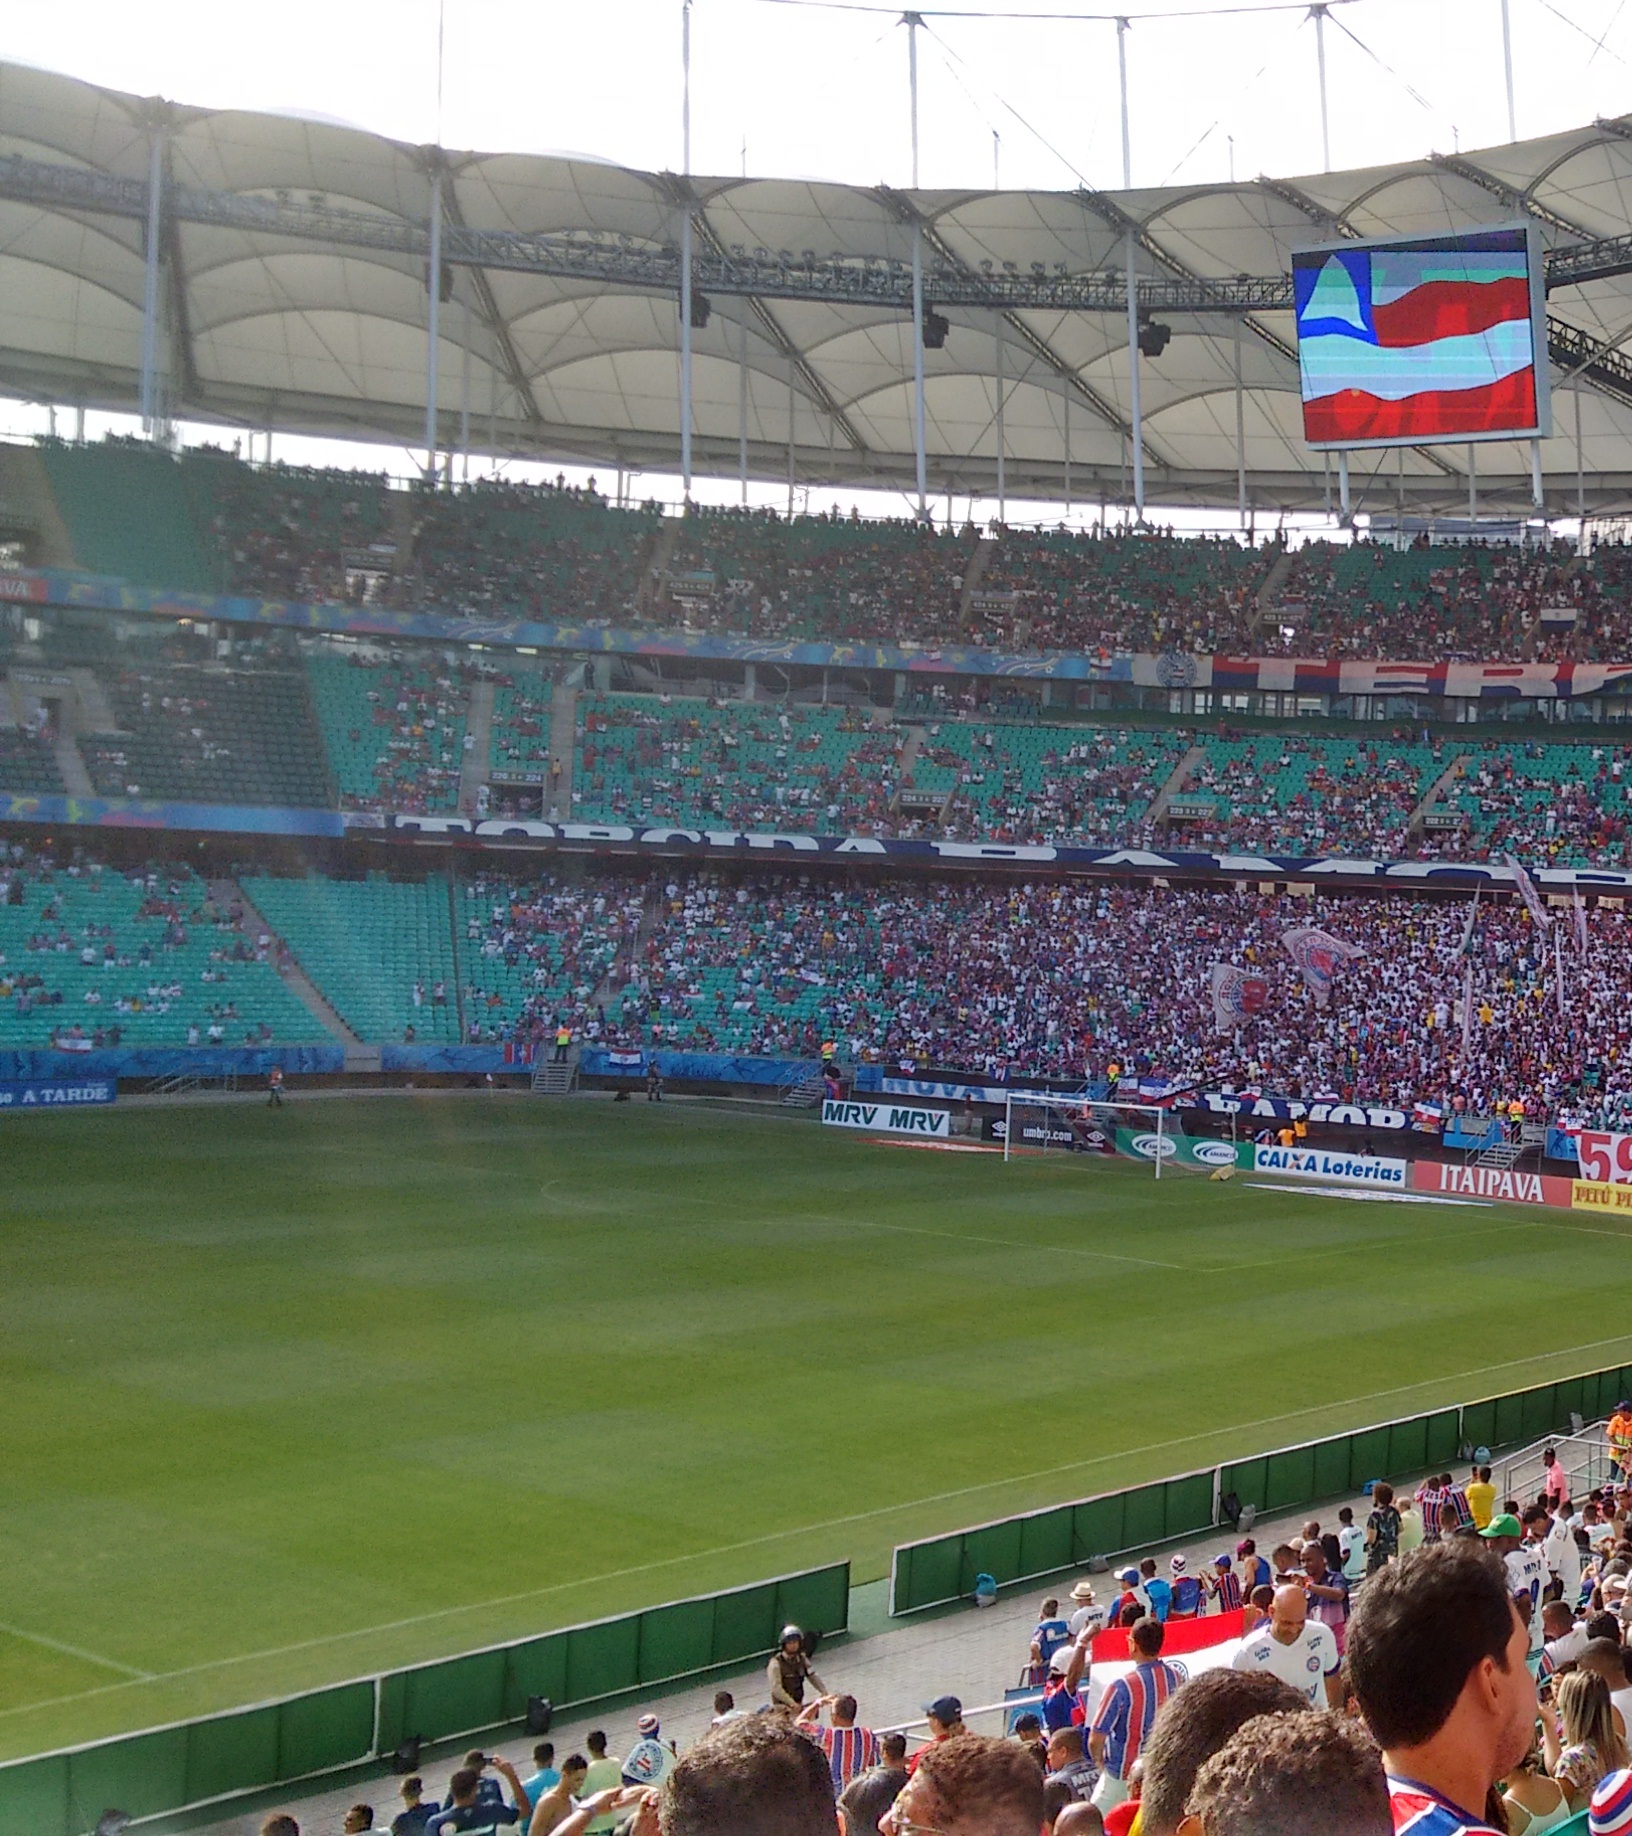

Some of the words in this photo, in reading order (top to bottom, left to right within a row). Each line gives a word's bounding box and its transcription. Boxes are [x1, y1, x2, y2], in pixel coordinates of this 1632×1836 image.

[21, 1089, 37, 1103] A
[41, 1087, 108, 1103] TARDE
[824, 1102, 879, 1126] MRV
[889, 1108, 946, 1132] MRV
[1256, 1149, 1318, 1172] CAIXA
[1322, 1157, 1403, 1183] Loterias
[1439, 1163, 1545, 1203] ITAIPAVA
[1574, 1182, 1610, 1204] PITÚ
